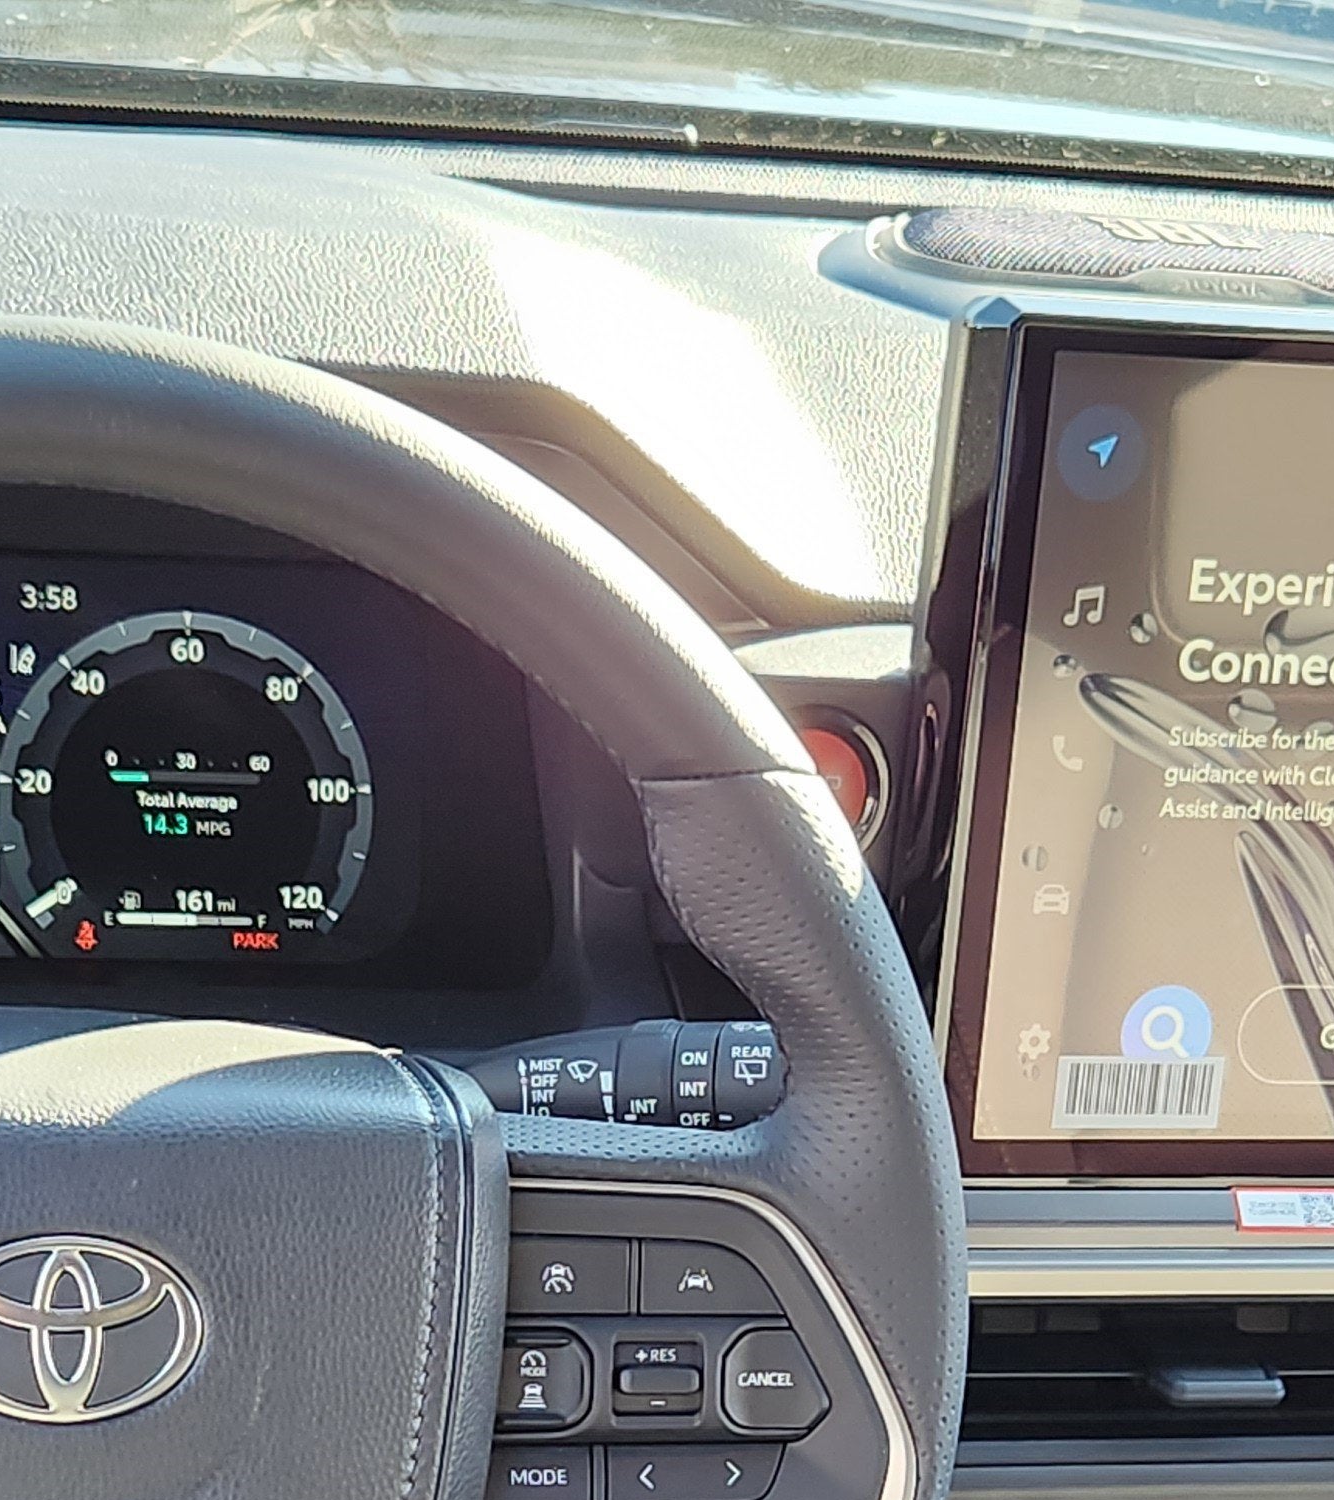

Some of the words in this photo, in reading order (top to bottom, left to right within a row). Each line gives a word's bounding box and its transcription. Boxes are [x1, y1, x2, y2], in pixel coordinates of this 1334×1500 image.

[19, 583, 78, 612] 3:58
[170, 638, 205, 663] 60
[71, 670, 105, 696] 40
[266, 676, 299, 702] 80
[1168, 726, 1267, 749] Subscribe
[1271, 728, 1300, 750] for
[104, 749, 118, 767] 0
[176, 752, 197, 770] 30
[248, 755, 271, 773] 60
[19, 769, 52, 794] 20
[1163, 765, 1258, 788] guidance
[1262, 766, 1306, 787] with
[307, 778, 350, 803] 100
[135, 790, 175, 808] Total
[177, 791, 238, 813] Average
[1159, 799, 1218, 820] Assist
[1221, 800, 1261, 821] and
[142, 813, 188, 835] 14.3
[195, 821, 232, 836] MPG
[176, 890, 214, 912] 161
[217, 899, 237, 912] mi
[279, 886, 323, 910] 120
[103, 911, 115, 927] E
[257, 914, 267, 929] F
[233, 932, 279, 949] PARK
[680, 1051, 708, 1066] ON
[731, 1045, 772, 1059] REAR
[530, 1058, 563, 1072] MIST
[530, 1074, 558, 1087] OFF
[679, 1081, 707, 1097] INT
[531, 1090, 556, 1103] INT
[630, 1099, 658, 1115] INT
[679, 1113, 711, 1127] OFF
[520, 1366, 547, 1378] MODE
[738, 1372, 794, 1388] CANCEL
[510, 1468, 568, 1486] MODE
